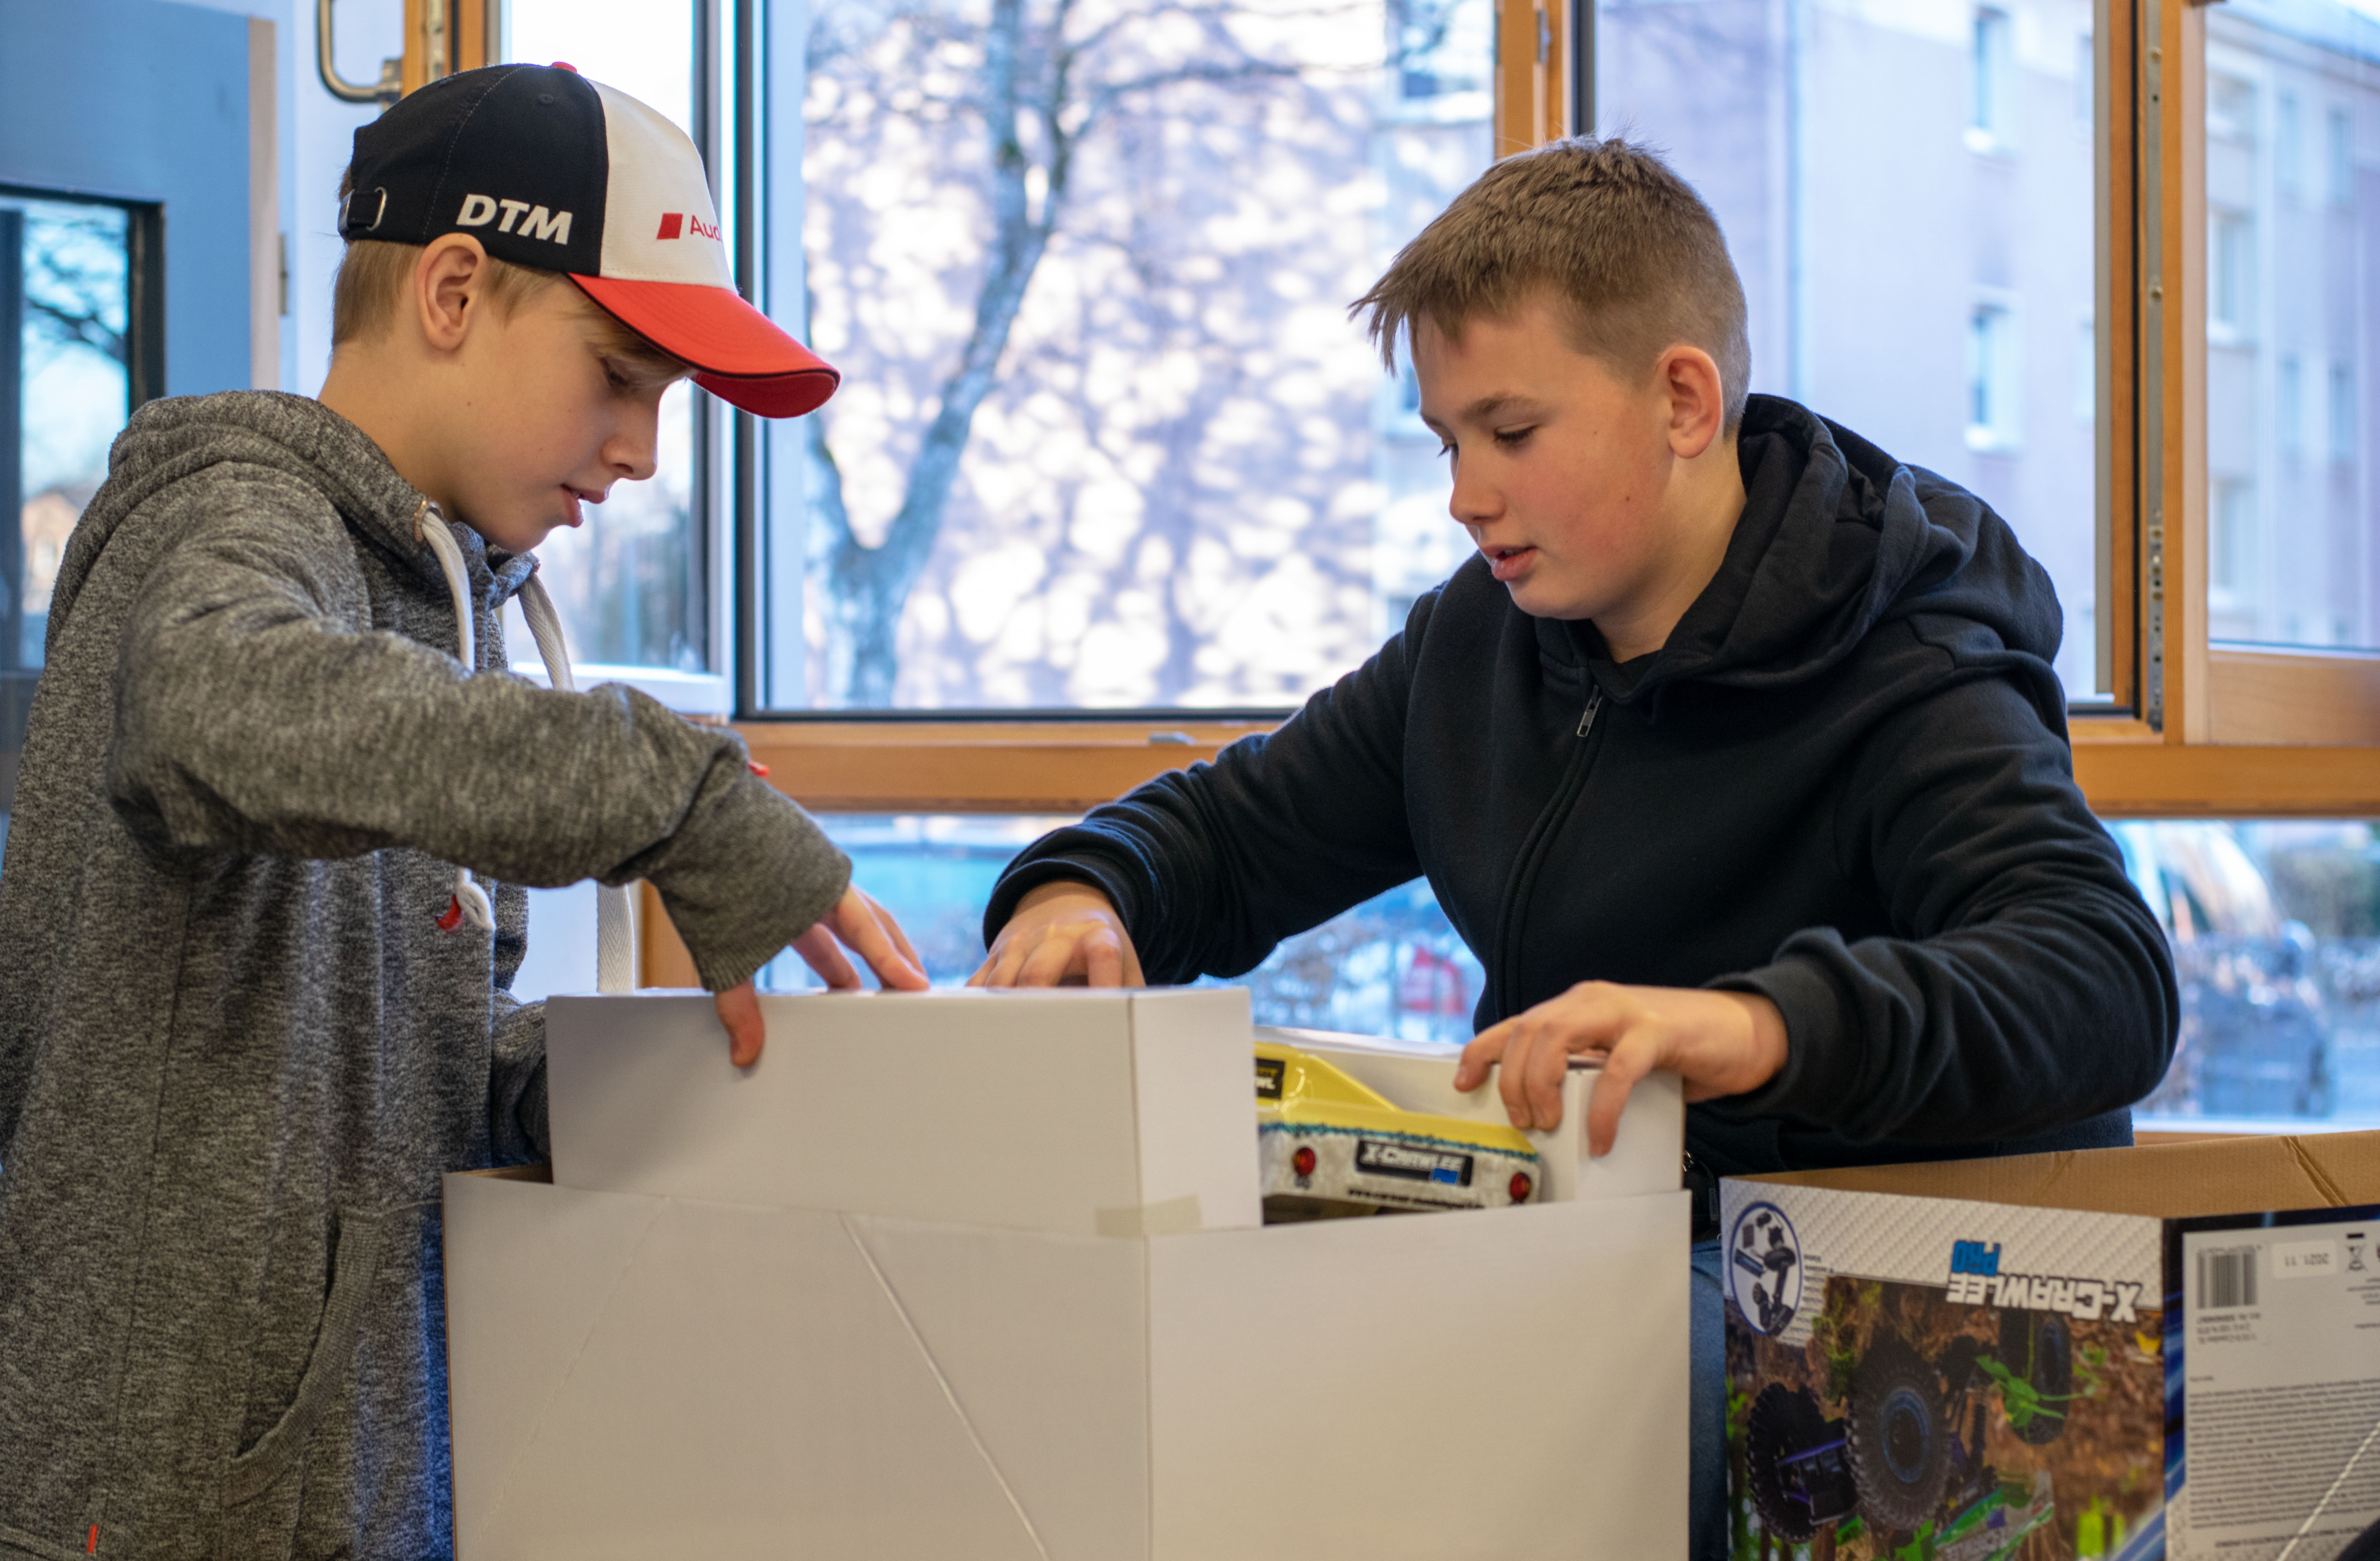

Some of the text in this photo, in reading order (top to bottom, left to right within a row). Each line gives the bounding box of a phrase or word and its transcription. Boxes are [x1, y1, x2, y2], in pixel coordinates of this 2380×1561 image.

[456, 193, 573, 245] DTM
[690, 215, 722, 242] Aud
[1946, 1272, 2142, 1323] X-CRAWLEE
